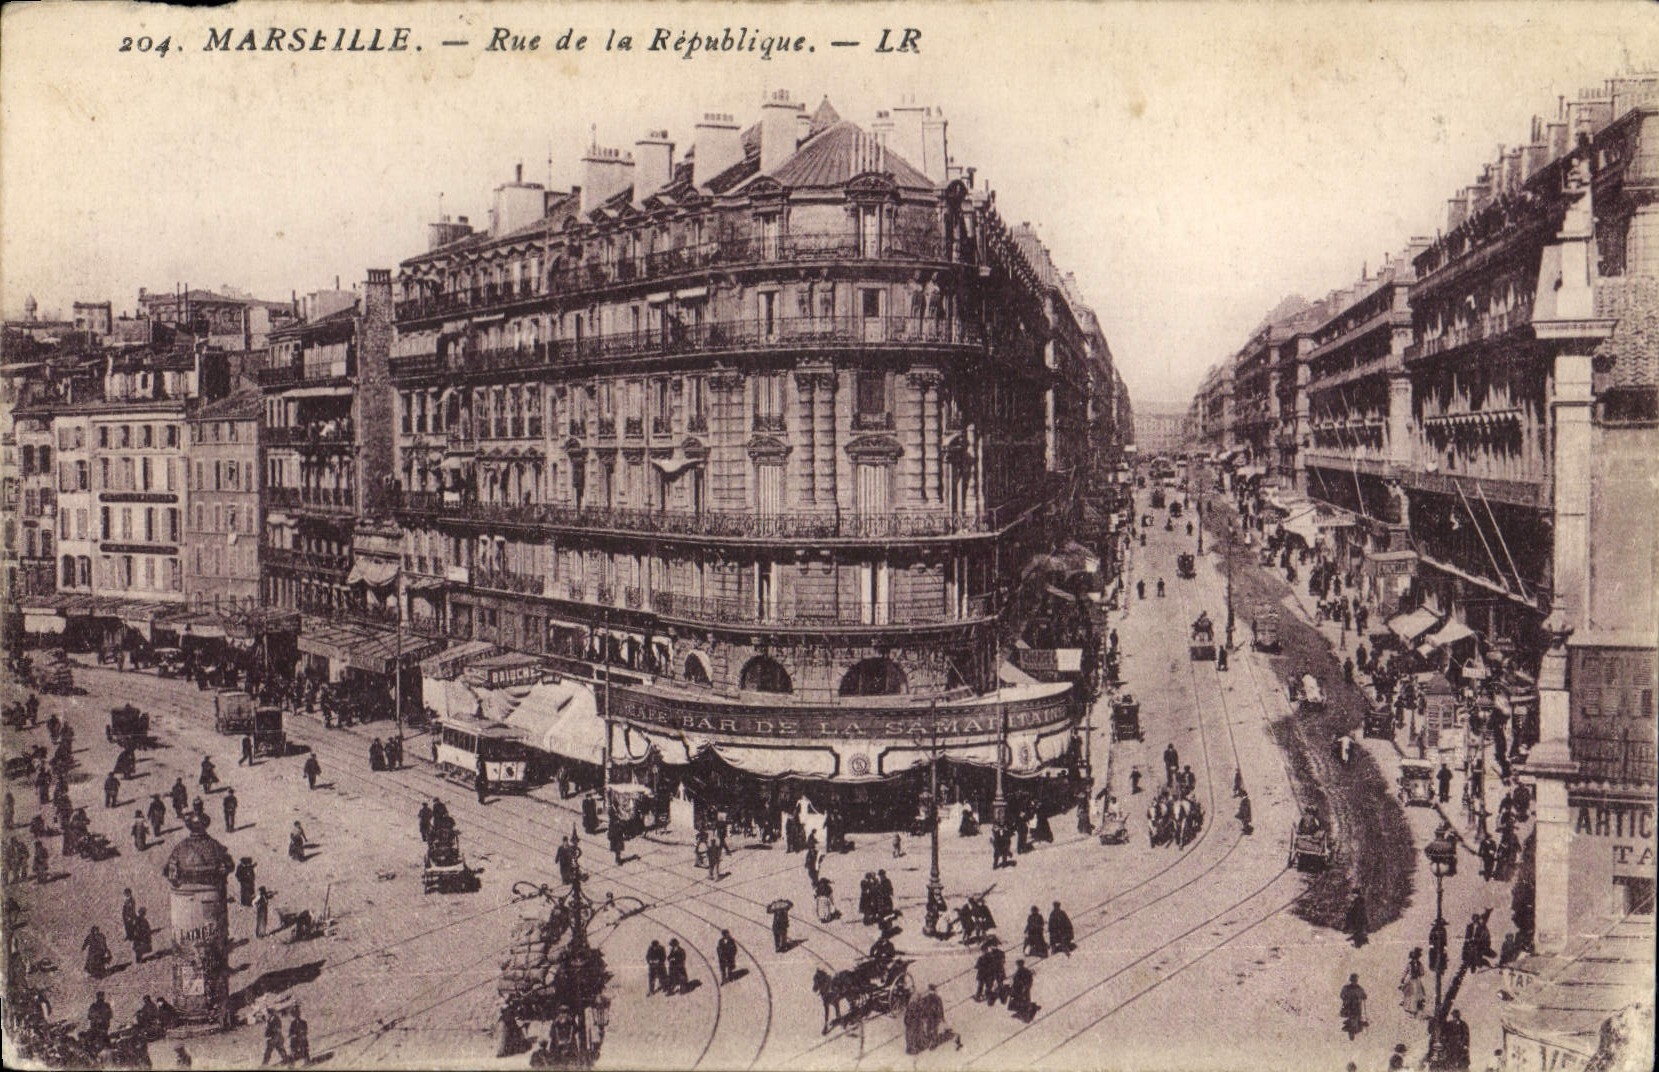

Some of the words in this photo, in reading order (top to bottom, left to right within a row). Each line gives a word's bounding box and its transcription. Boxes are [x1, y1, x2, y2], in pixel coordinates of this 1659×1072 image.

[683, 714, 738, 732] BAR
[755, 720, 798, 734] DE
[820, 722, 867, 735] LA
